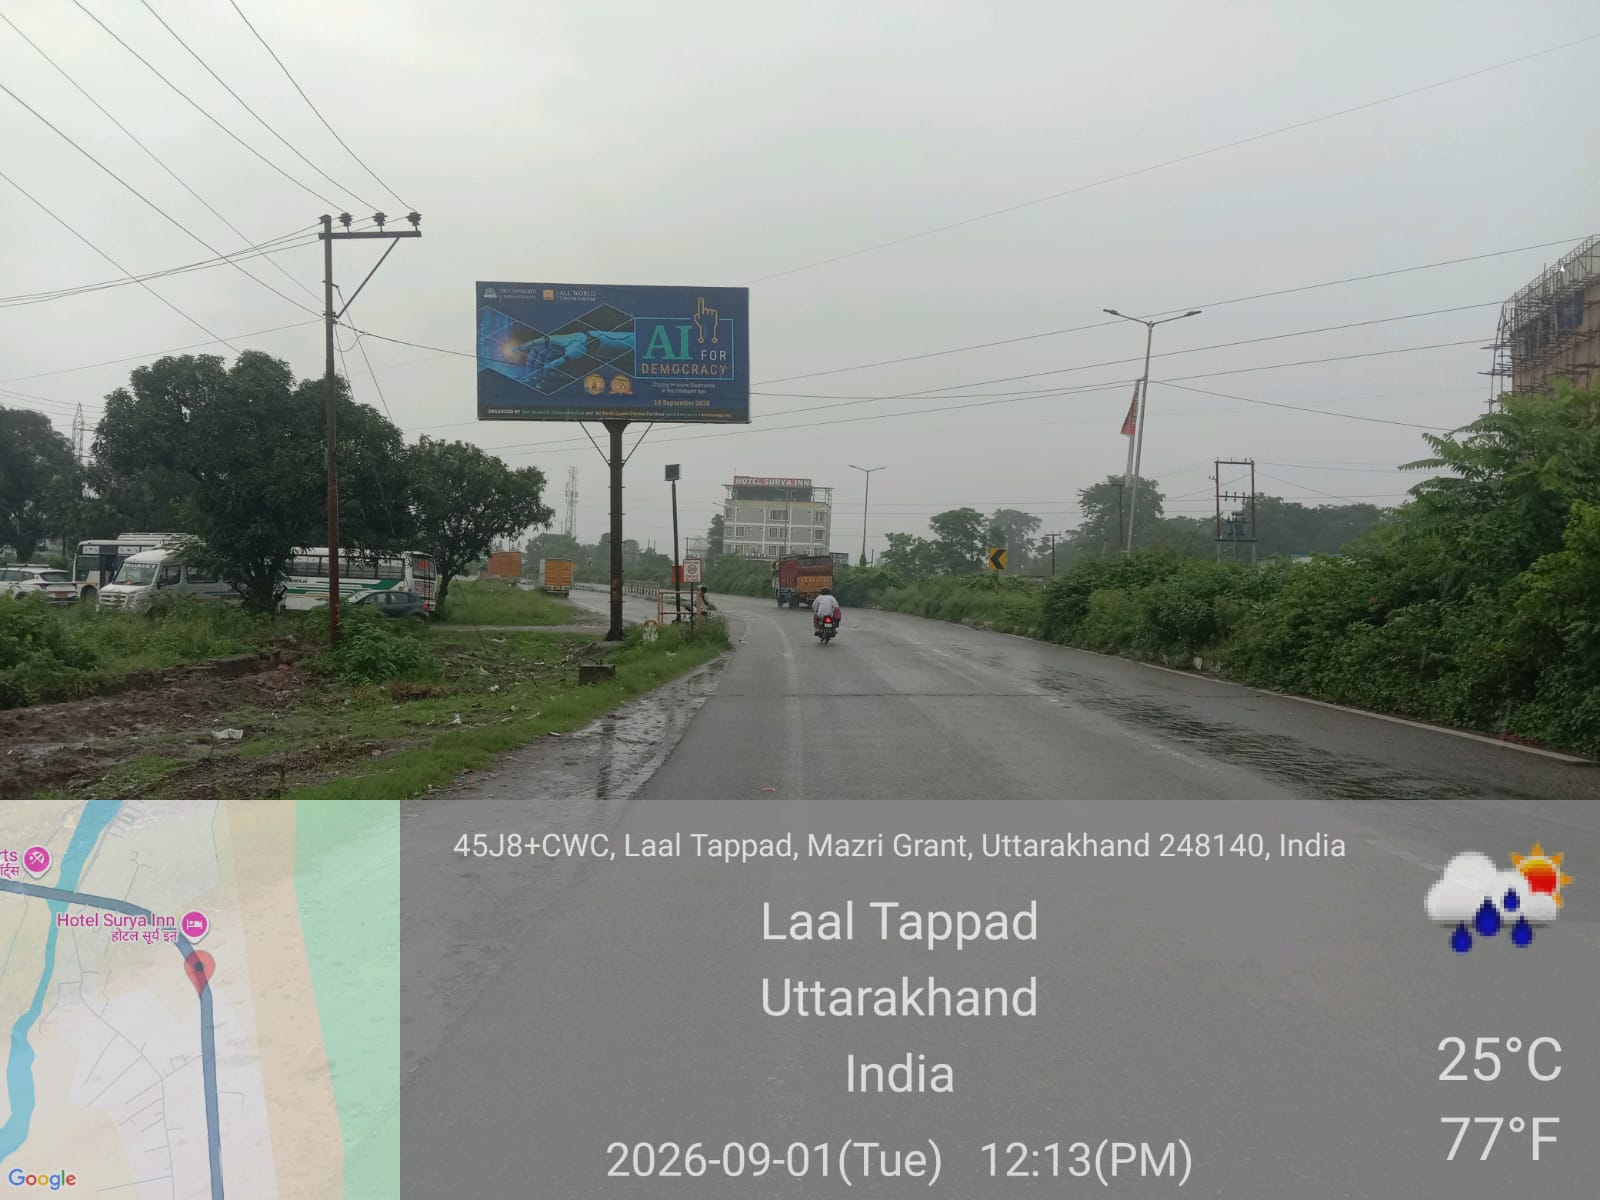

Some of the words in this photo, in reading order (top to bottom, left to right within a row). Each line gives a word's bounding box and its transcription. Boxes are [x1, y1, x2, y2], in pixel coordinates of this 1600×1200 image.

[642, 324, 694, 360] AI
[701, 349, 727, 361] FOR
[641, 362, 728, 376] DEMOCRACY
[735, 477, 762, 485] HOTEL
[764, 478, 792, 486] SURYA
[794, 479, 810, 487] INN
